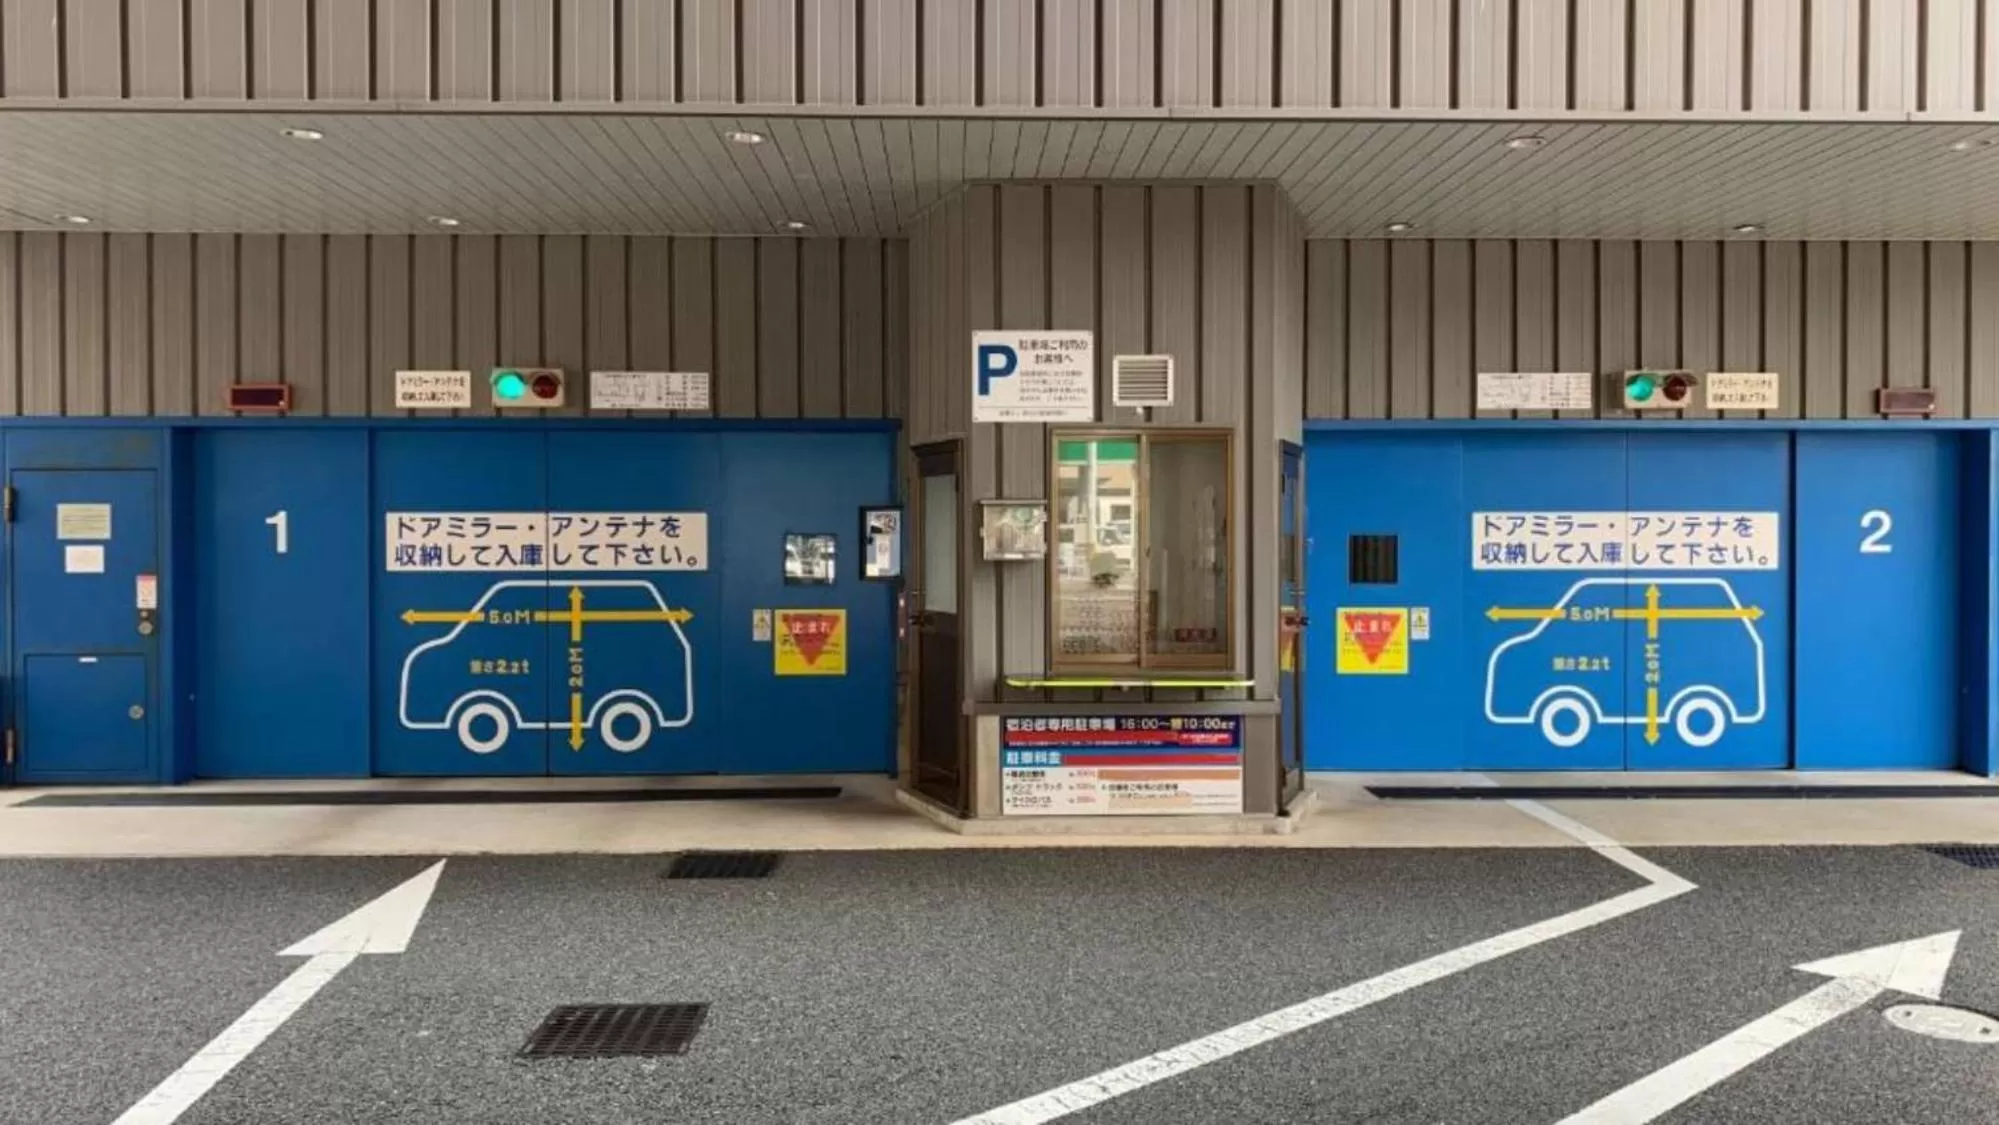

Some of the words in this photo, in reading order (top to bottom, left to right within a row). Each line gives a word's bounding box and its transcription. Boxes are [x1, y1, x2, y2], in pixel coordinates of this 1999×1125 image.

[978, 345, 1018, 396] P
[265, 510, 287, 553] 1
[1860, 509, 1892, 553] 2
[395, 543, 698, 567] 収納して入庫して下さい。
[1481, 542, 1769, 566] 収納して入庫して下さい。
